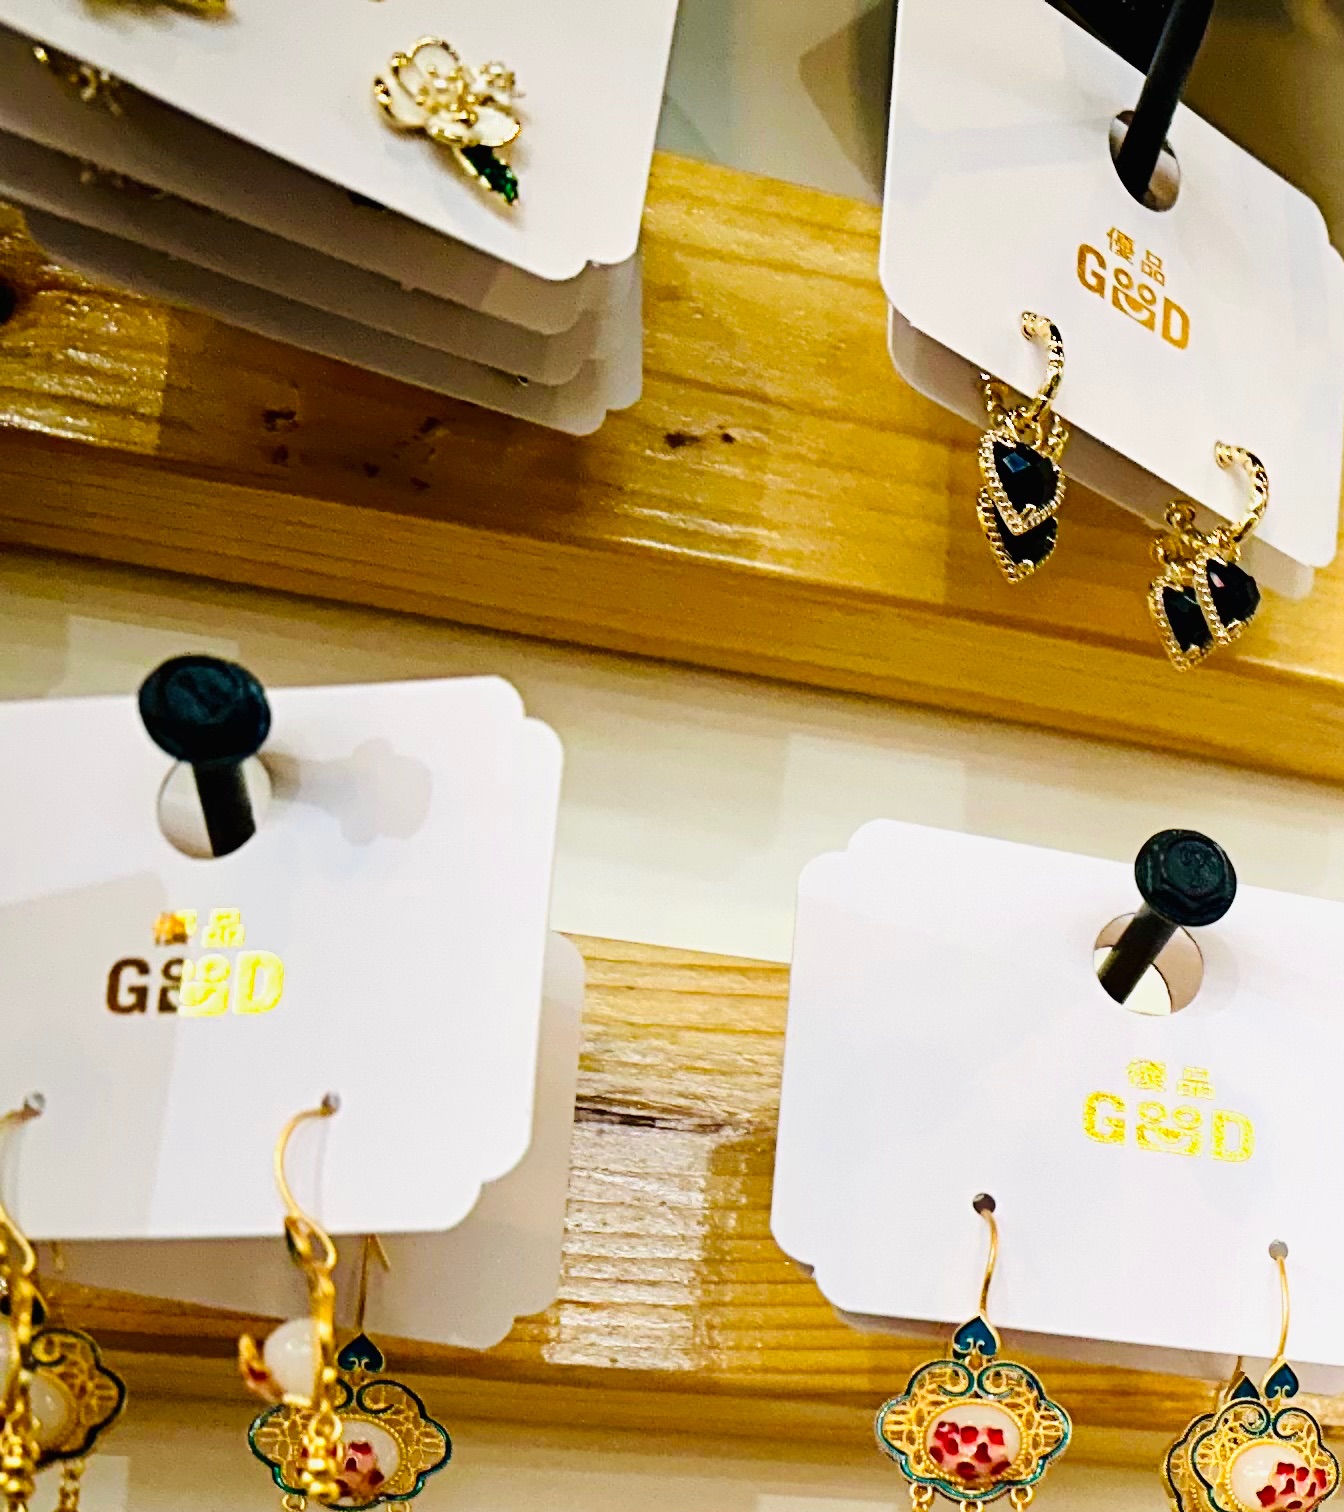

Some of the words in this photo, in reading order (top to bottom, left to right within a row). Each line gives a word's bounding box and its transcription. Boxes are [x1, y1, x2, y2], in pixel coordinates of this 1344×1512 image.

[1106, 228, 1166, 286] 優品
[1077, 244, 1190, 350] GOOD
[106, 950, 284, 1017] GOOD
[1082, 1091, 1255, 1162] GOOD
